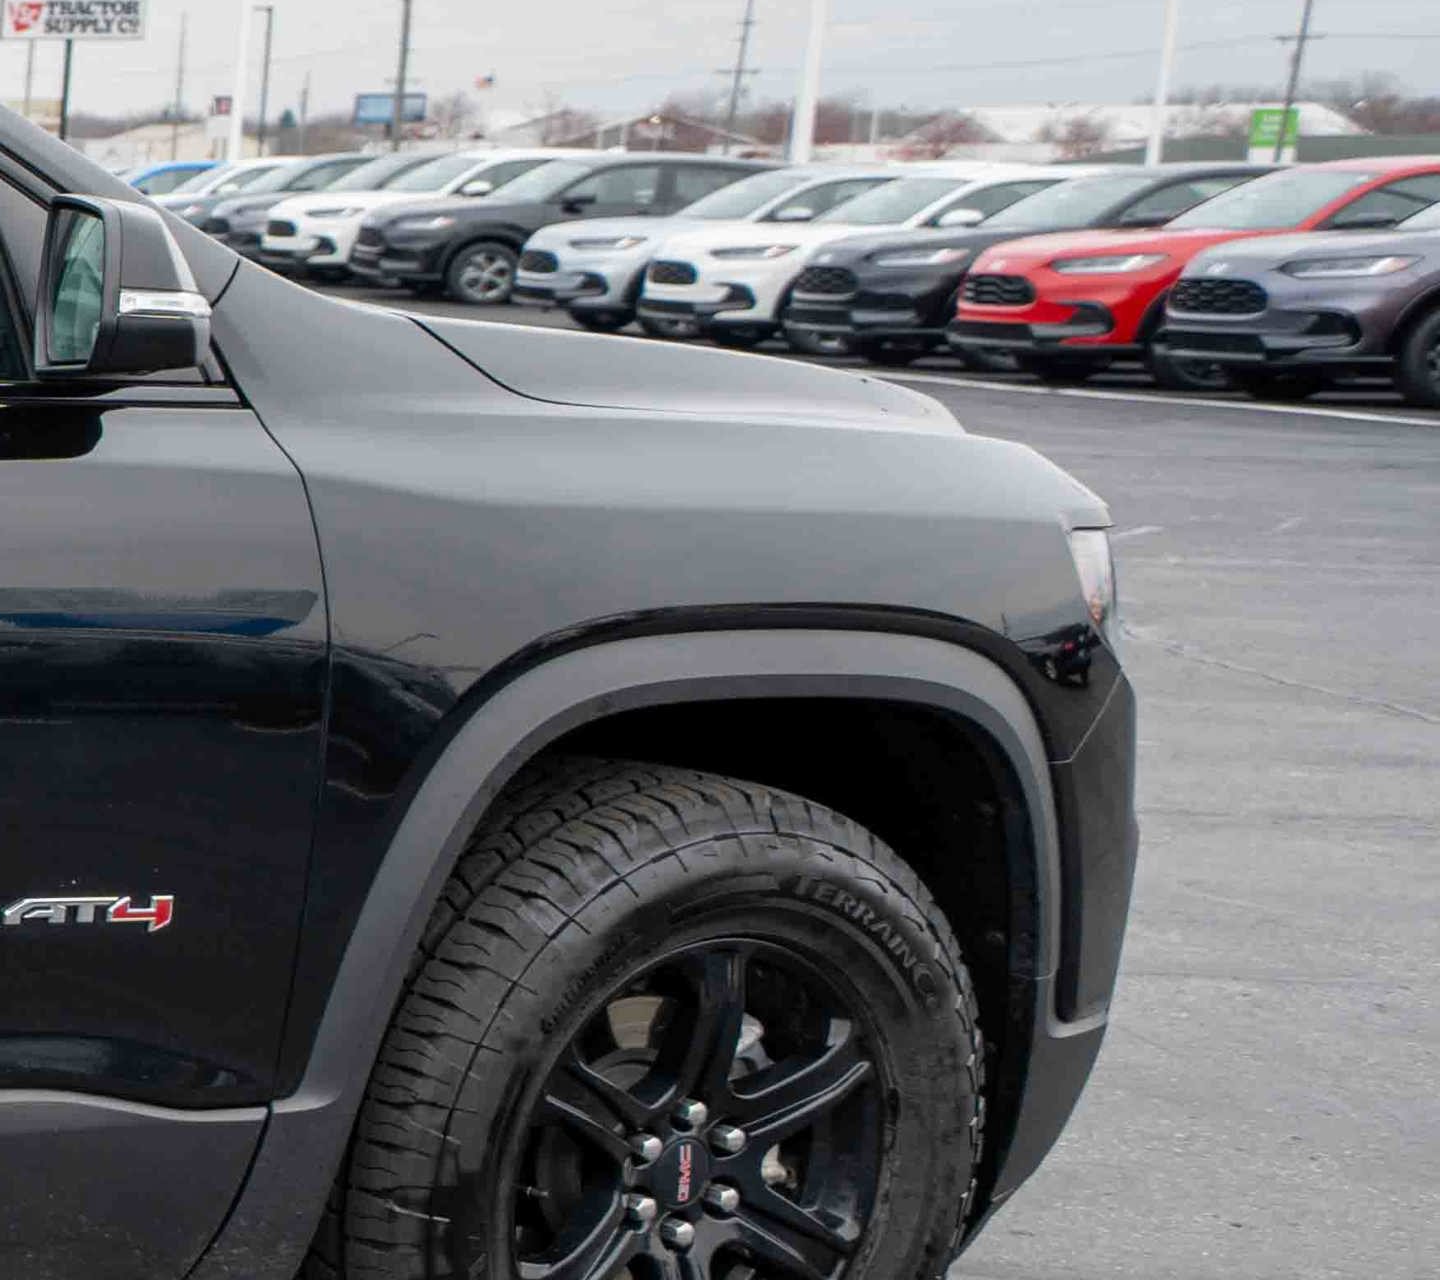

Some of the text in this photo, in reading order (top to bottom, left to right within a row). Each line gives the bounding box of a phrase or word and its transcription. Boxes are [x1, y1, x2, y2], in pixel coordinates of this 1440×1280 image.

[46, 0, 140, 15] TRACTOR
[44, 18, 114, 33] SUPPLY
[1, 895, 174, 932] AT4
[677, 1144, 691, 1202] GMC
